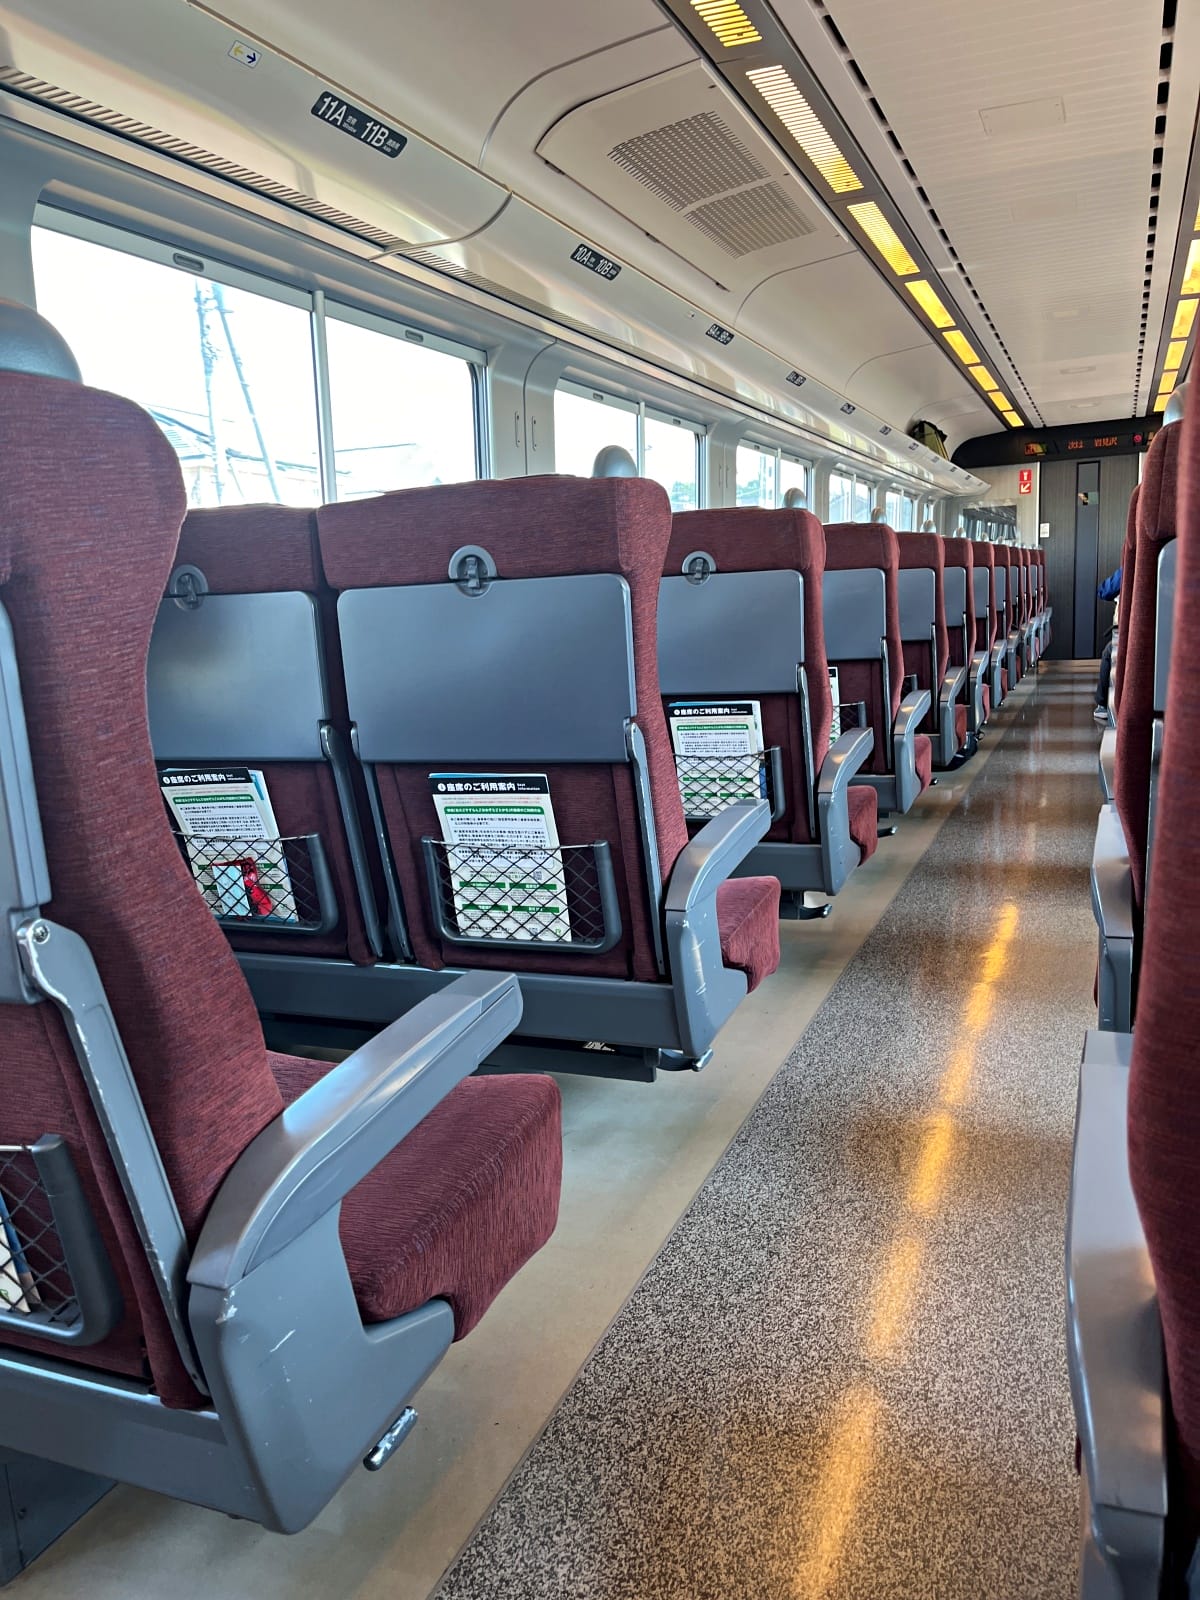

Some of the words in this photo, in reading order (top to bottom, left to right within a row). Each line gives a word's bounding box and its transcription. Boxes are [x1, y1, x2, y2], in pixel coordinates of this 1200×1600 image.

[317, 97, 347, 126] 11A
[360, 121, 389, 147] 11B
[574, 247, 591, 264] 10A
[595, 259, 612, 275] 10B
